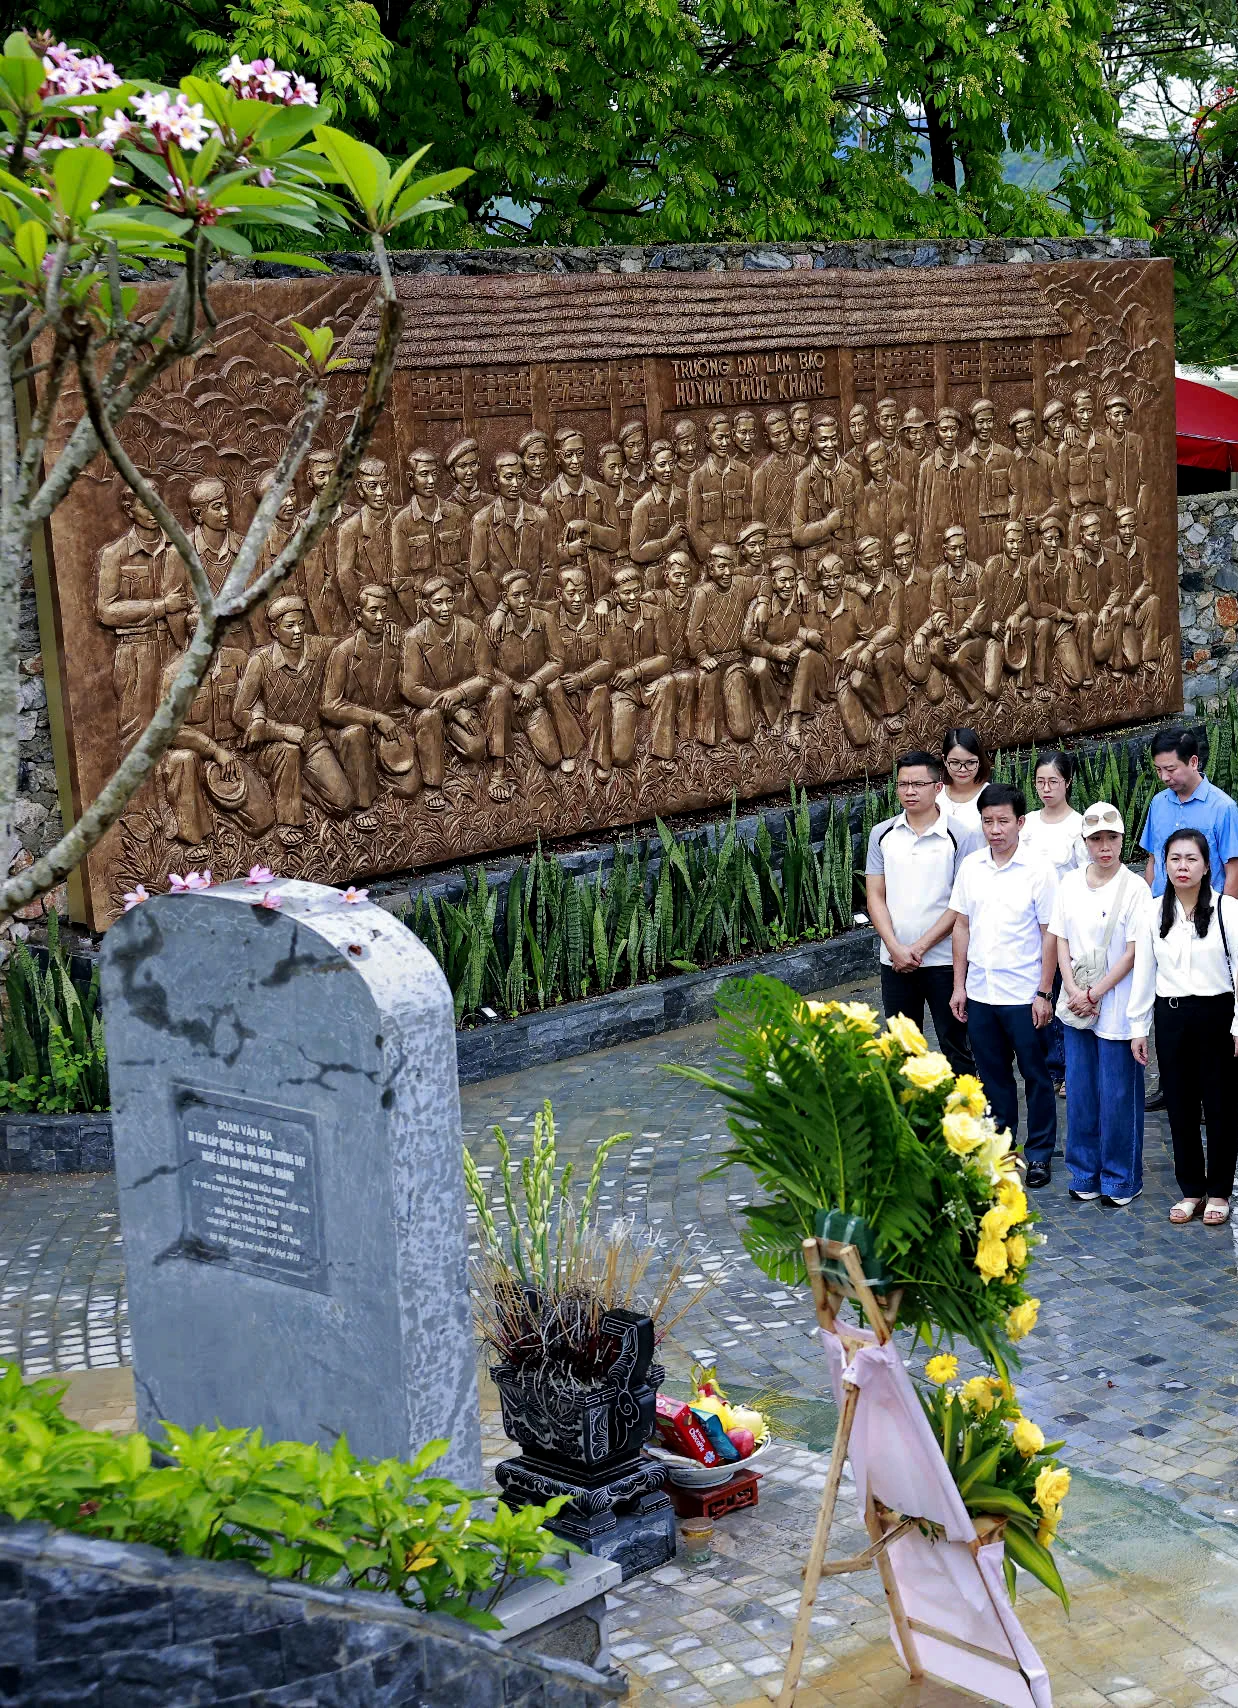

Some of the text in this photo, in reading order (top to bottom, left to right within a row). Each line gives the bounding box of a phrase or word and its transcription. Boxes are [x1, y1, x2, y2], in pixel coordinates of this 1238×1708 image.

[671, 349, 826, 379] TRƯỜNG DẠY LÀM BÁO
[674, 370, 826, 406] HUỲNH THÚC KHÁNG
[217, 1120, 273, 1142] SOẠN VĂN BIA
